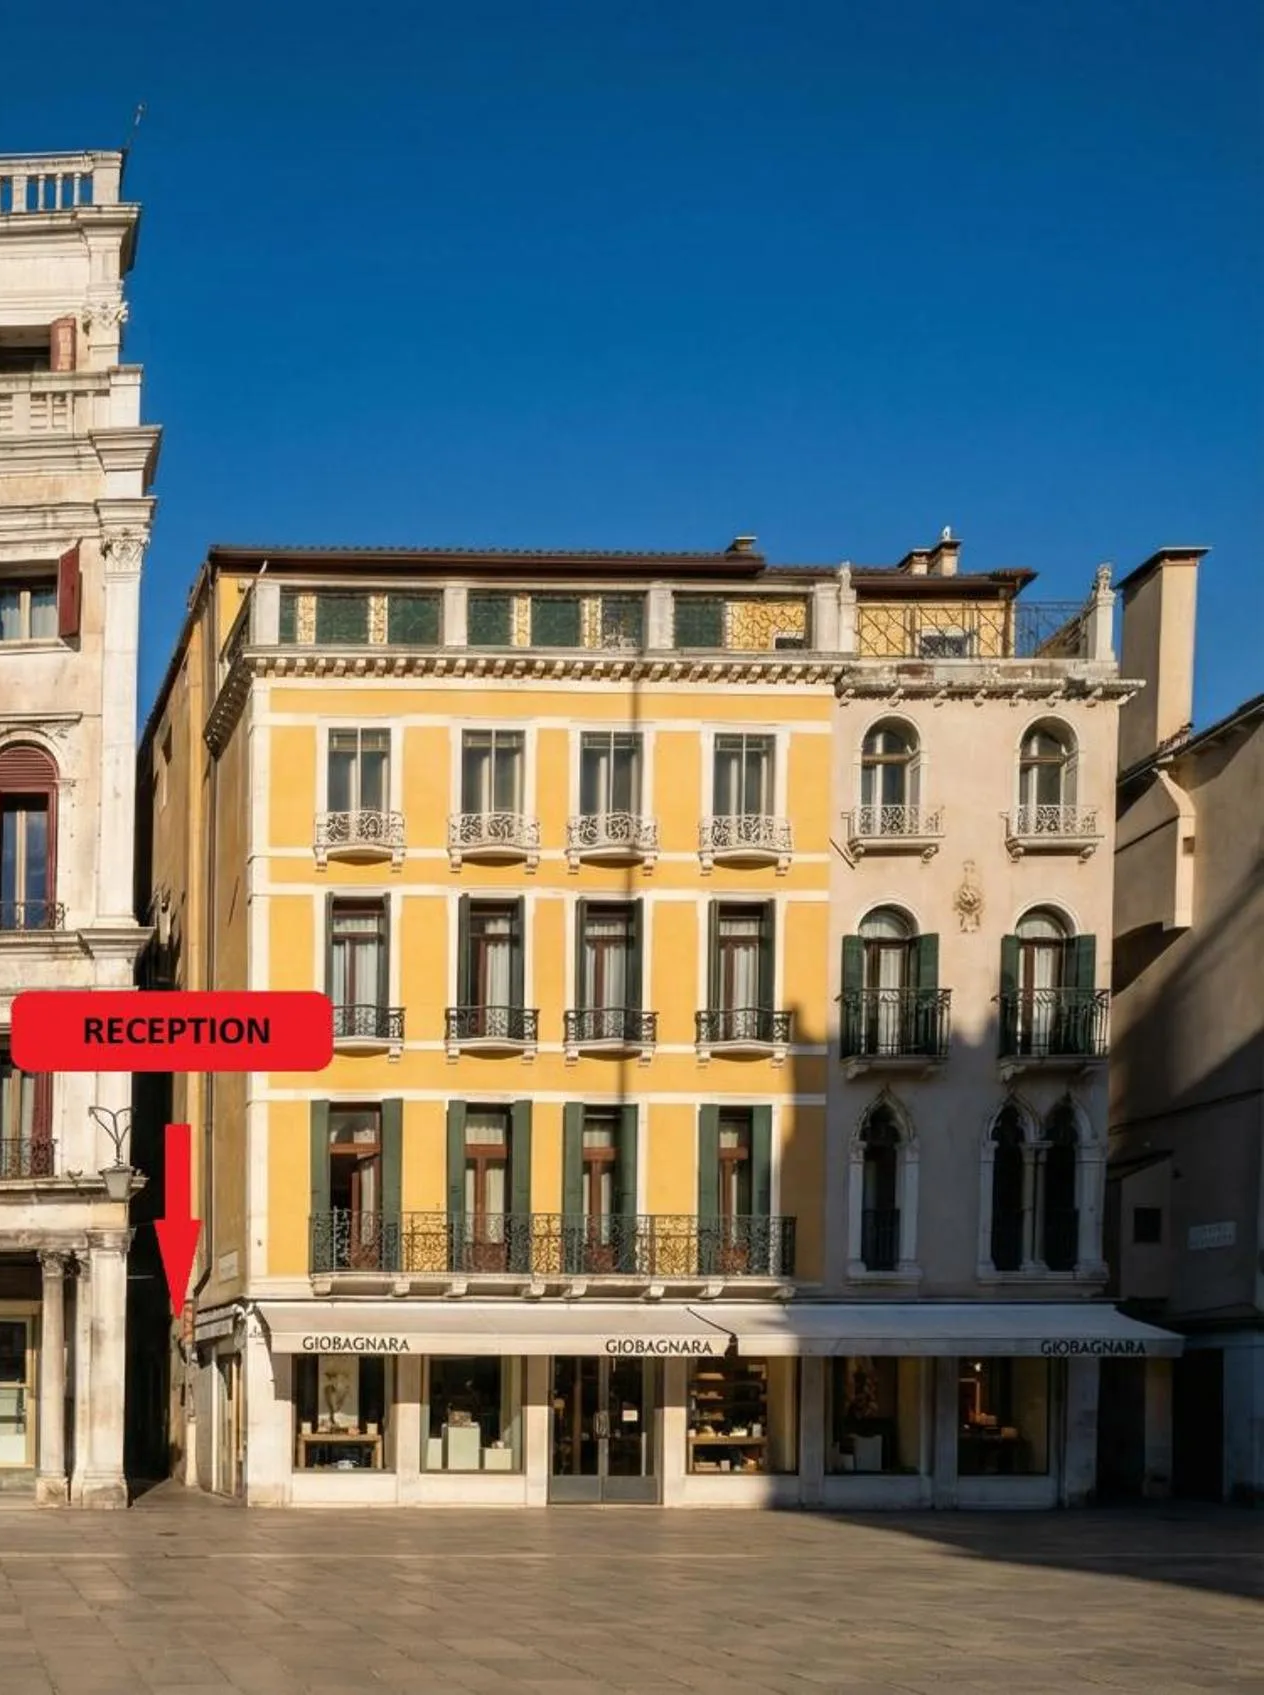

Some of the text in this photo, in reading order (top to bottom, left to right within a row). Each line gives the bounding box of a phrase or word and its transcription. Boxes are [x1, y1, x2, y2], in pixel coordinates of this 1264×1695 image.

[302, 1336, 410, 1351] GIOBAGNARA
[605, 1339, 713, 1354] GIOBAGNARA
[1040, 1340, 1146, 1354] GIOBAGNARA
